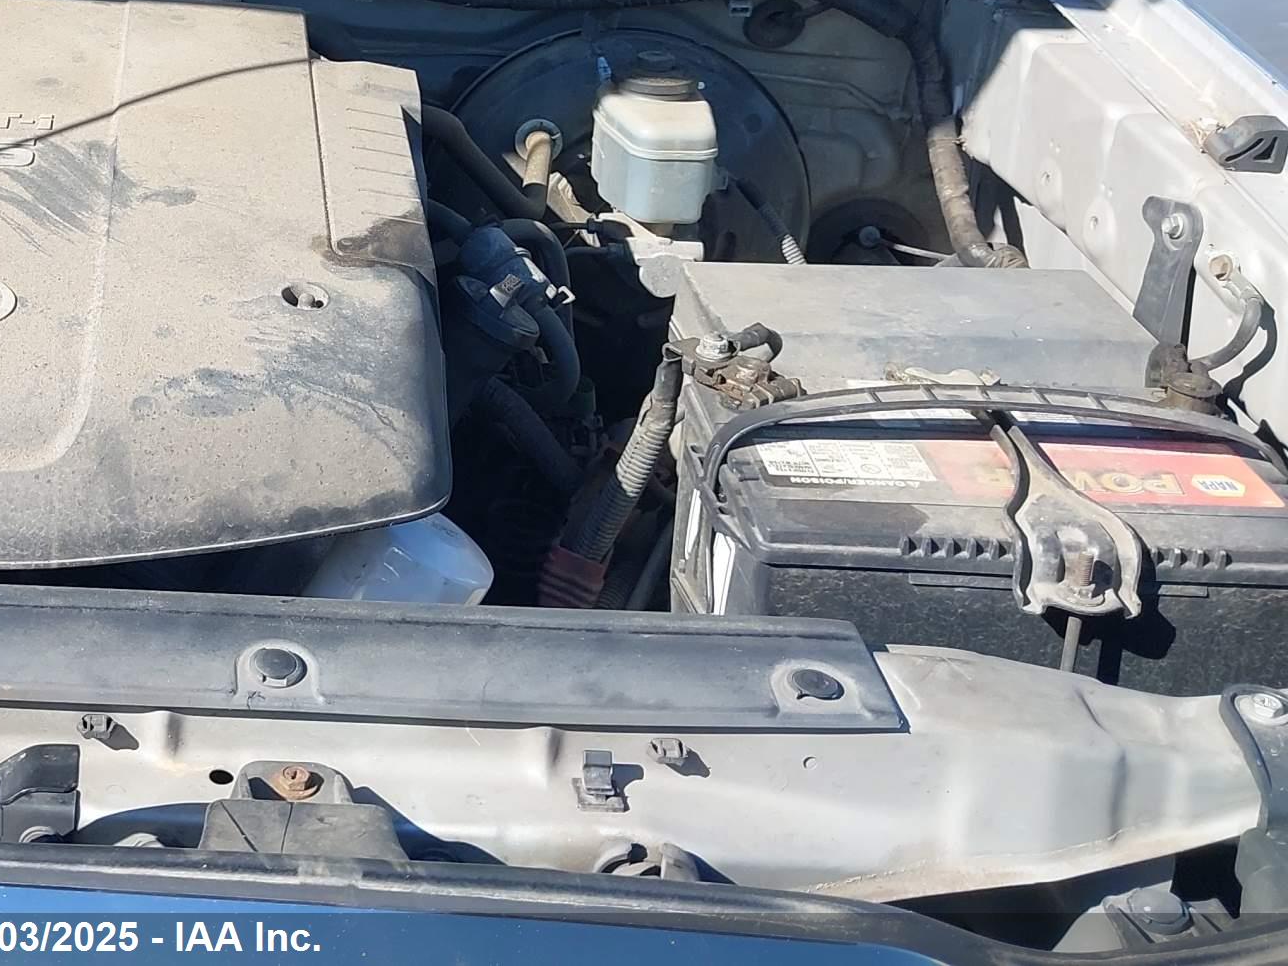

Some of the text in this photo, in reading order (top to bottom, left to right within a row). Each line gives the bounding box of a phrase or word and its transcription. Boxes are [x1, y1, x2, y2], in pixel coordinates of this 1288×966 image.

[789, 476, 907, 487] DANGER/POISON
[977, 469, 1238, 496] NAPA POWR
